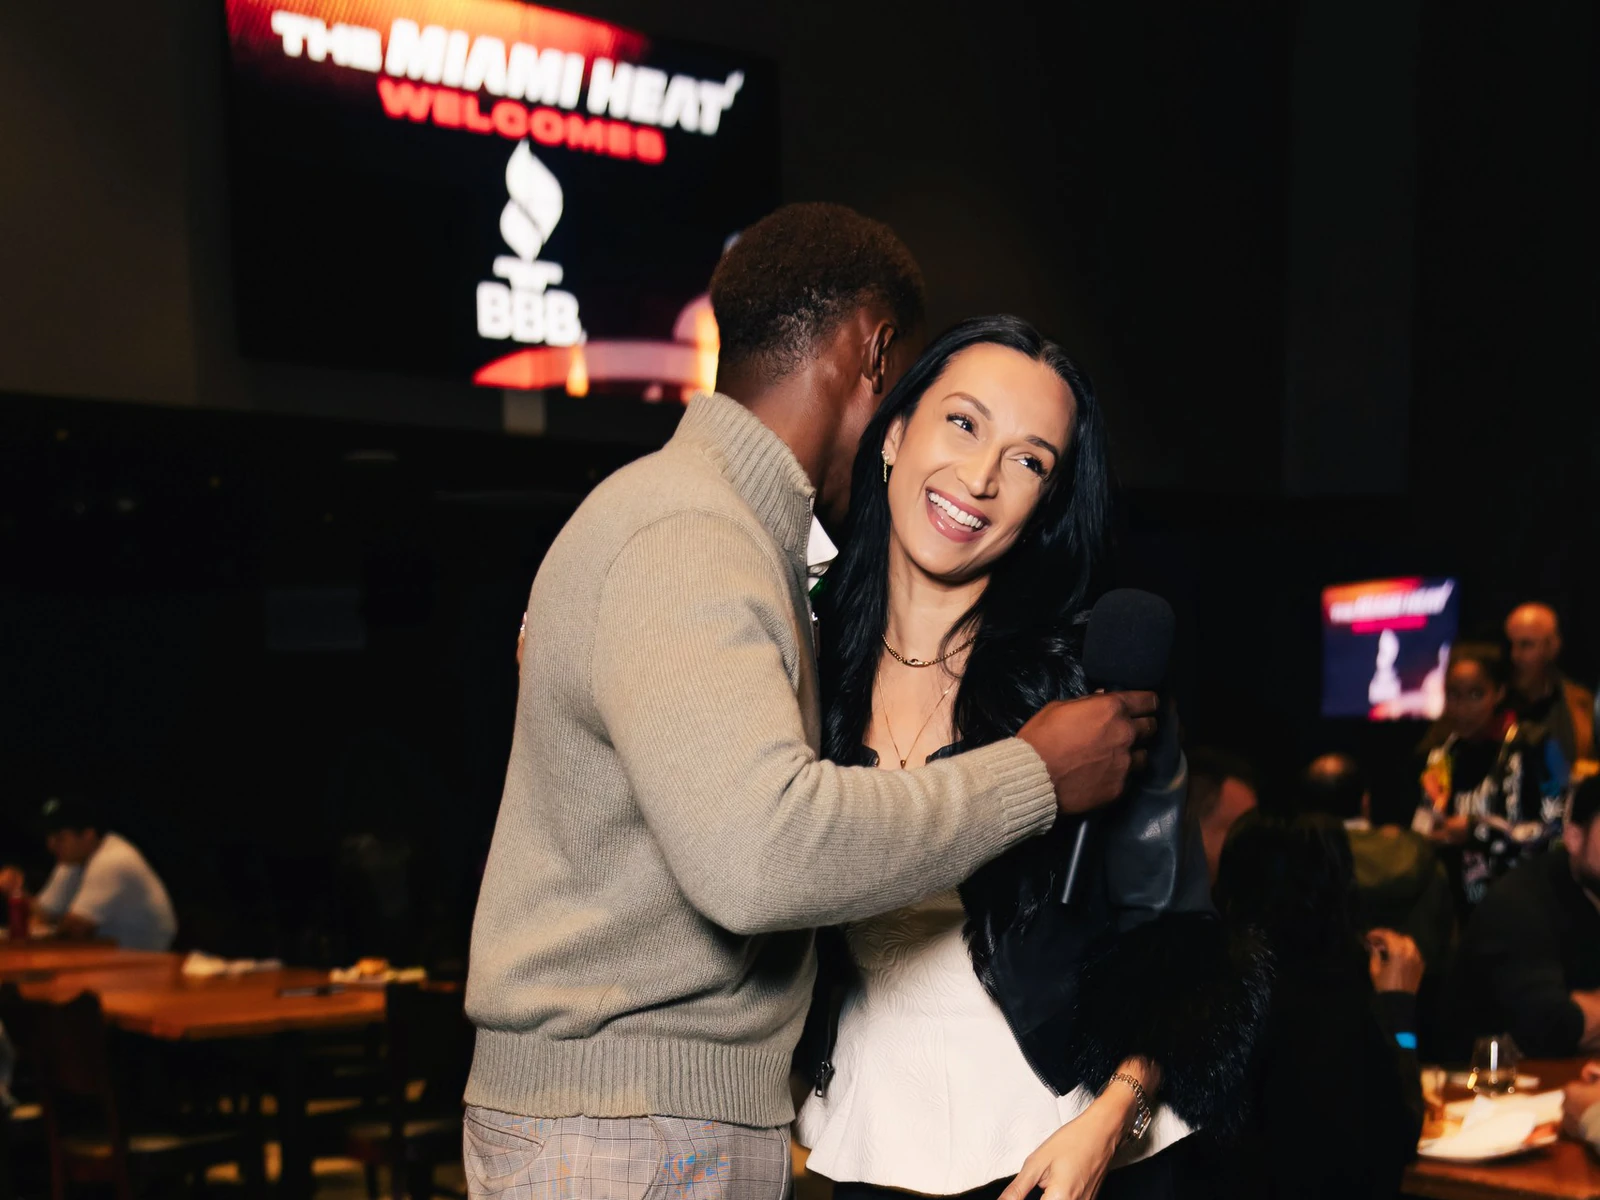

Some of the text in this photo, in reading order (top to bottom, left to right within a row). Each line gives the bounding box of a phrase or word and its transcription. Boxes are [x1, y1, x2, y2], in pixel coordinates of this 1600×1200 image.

[270, 10, 745, 136] THE MIAMI HEAT
[377, 77, 667, 165] WELCOMES
[476, 280, 581, 347] BBB
